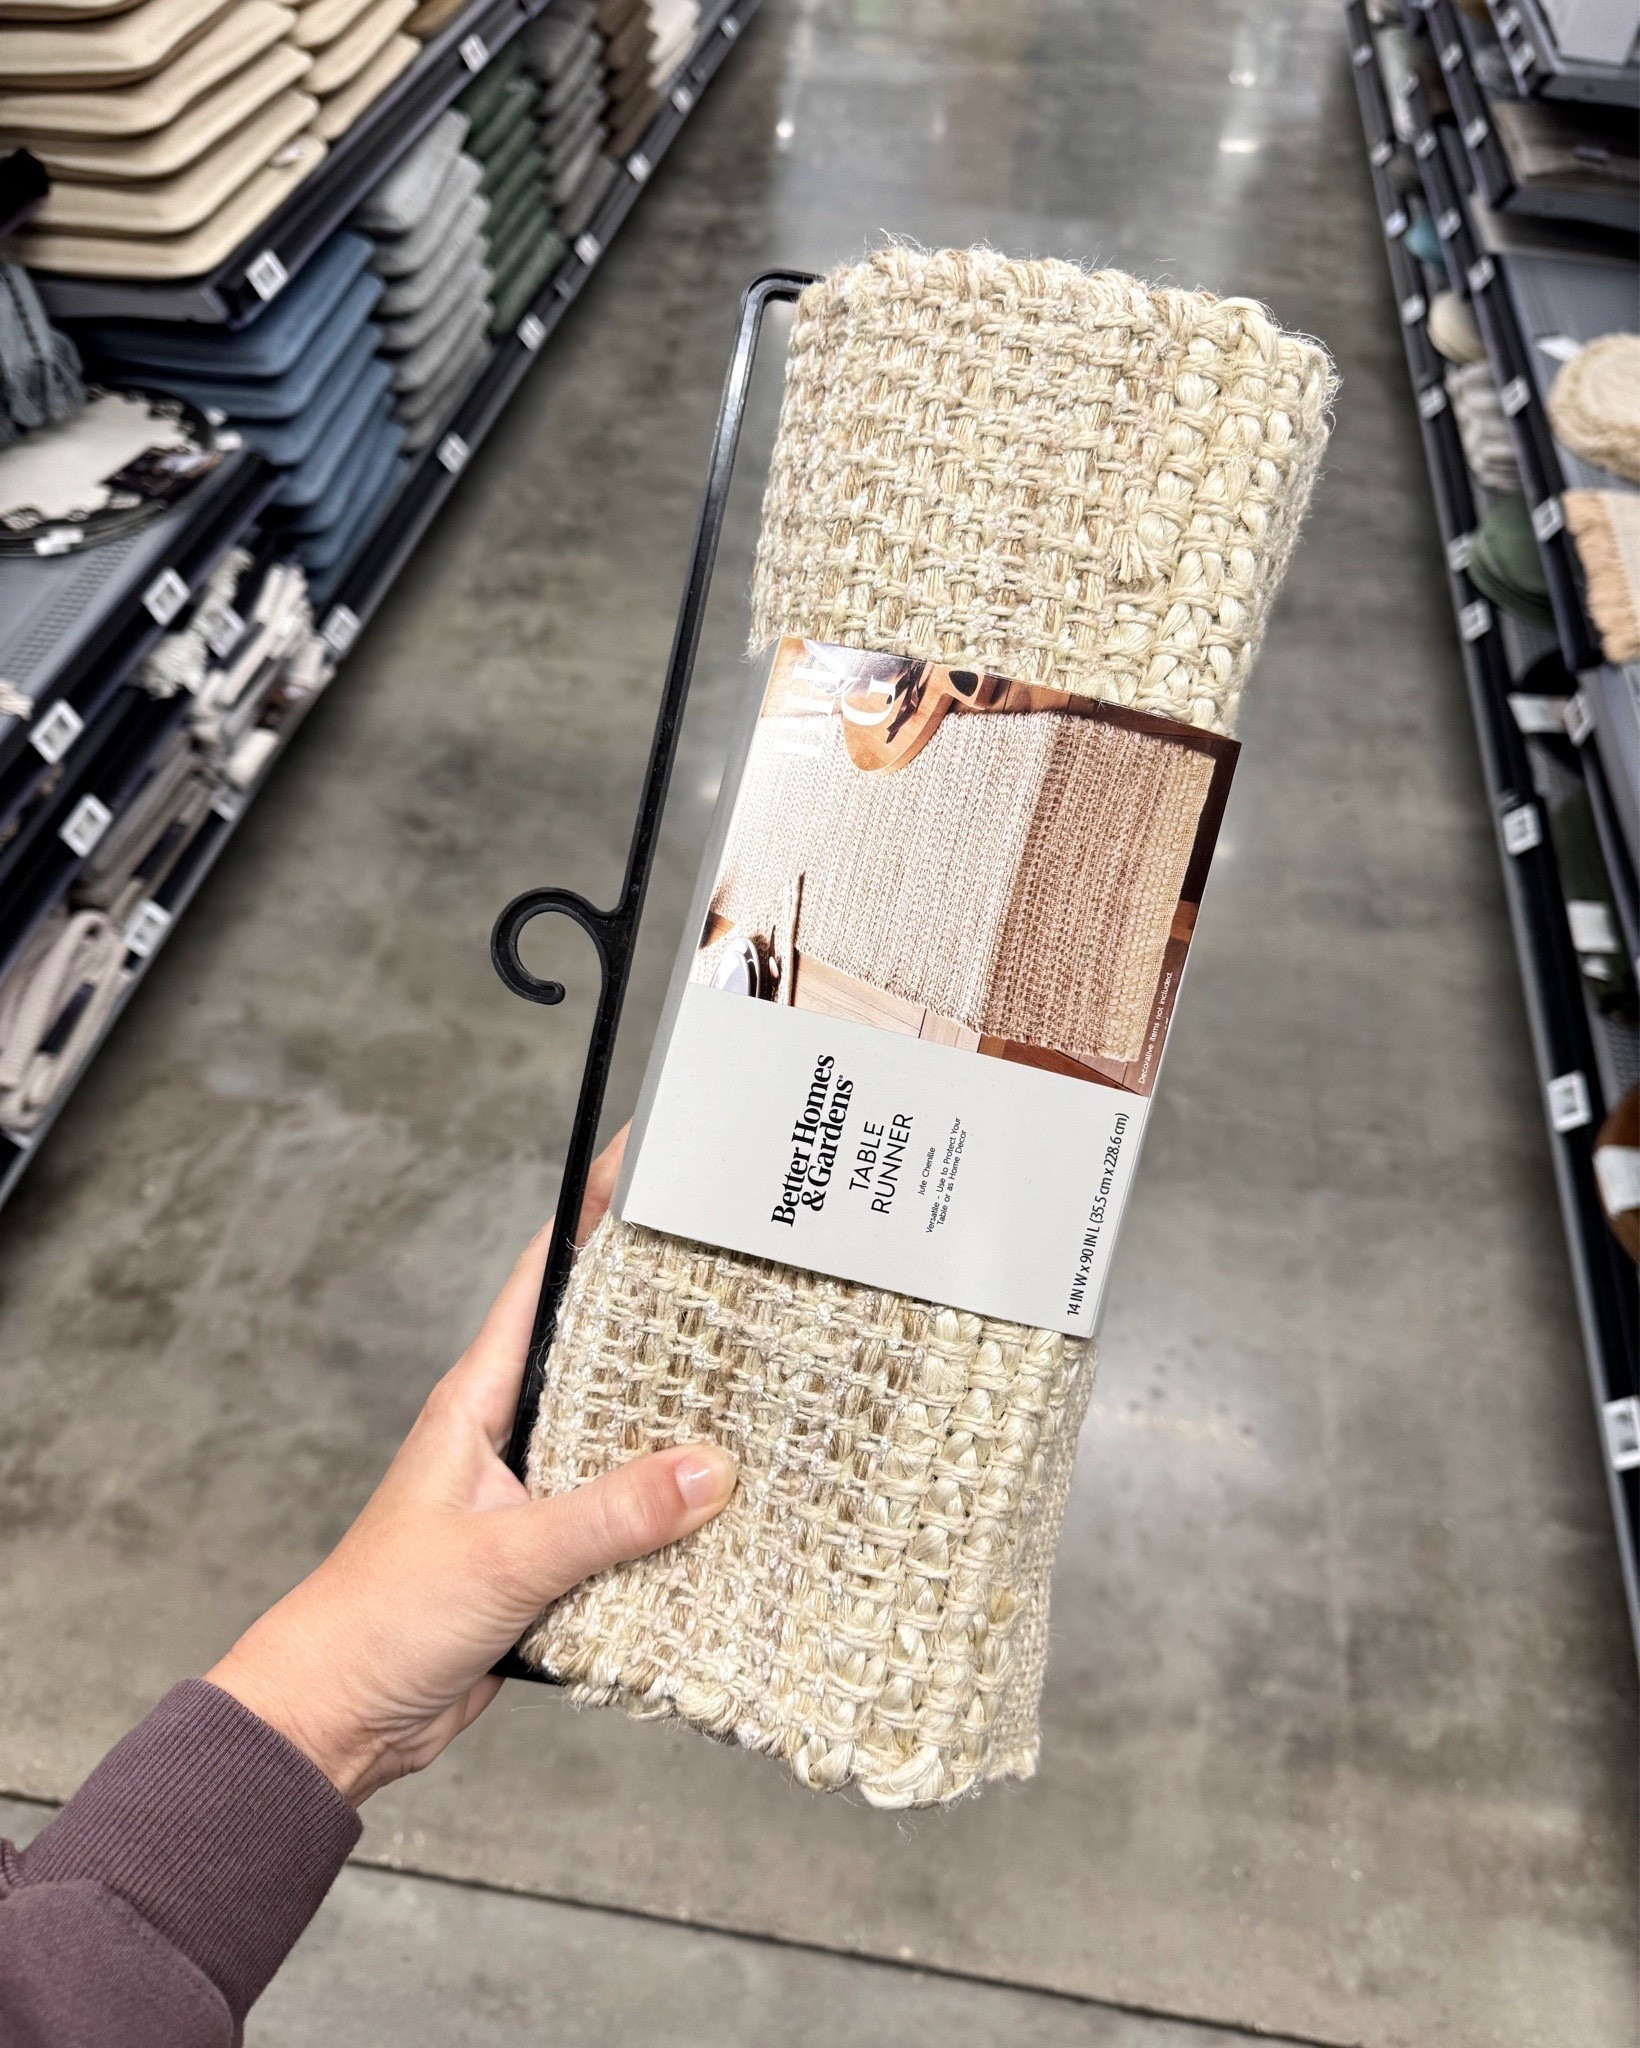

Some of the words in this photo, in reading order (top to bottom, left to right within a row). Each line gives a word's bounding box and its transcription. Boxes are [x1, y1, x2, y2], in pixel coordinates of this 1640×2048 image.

[1138, 1044, 1154, 1084] Decorative
[1149, 1022, 1160, 1042] items
[1155, 1007, 1164, 1020] not
[950, 1116, 961, 1135] Your
[1114, 1112, 1130, 1135] cm)
[771, 1147, 811, 1227] Better
[791, 1055, 835, 1147] Homes
[943, 1136, 957, 1165] Protect
[954, 1129, 967, 1154] Decor
[849, 1121, 885, 1190] TABLE
[922, 1146, 936, 1177] Chenille
[1103, 1136, 1122, 1168] 228.6
[871, 1114, 914, 1214] RUNNER
[940, 1167, 949, 1176] to
[948, 1156, 961, 1180] Home
[1104, 1167, 1115, 1177] x
[917, 1180, 928, 1196] Jute
[935, 1177, 946, 1193] Use
[946, 1182, 954, 1192] as
[1099, 1177, 1113, 1195] cm
[801, 1190, 827, 1212] &
[944, 1193, 951, 1203] or
[925, 1201, 940, 1233] Versatile
[936, 1204, 948, 1225] Table
[1088, 1195, 1107, 1224] (35.5
[1083, 1233, 1098, 1248] IN
[1079, 1248, 1094, 1264] 90
[1073, 1272, 1088, 1286] W
[1080, 1264, 1091, 1274] x
[1069, 1288, 1084, 1302] IN
[1066, 1303, 1081, 1316] 14
